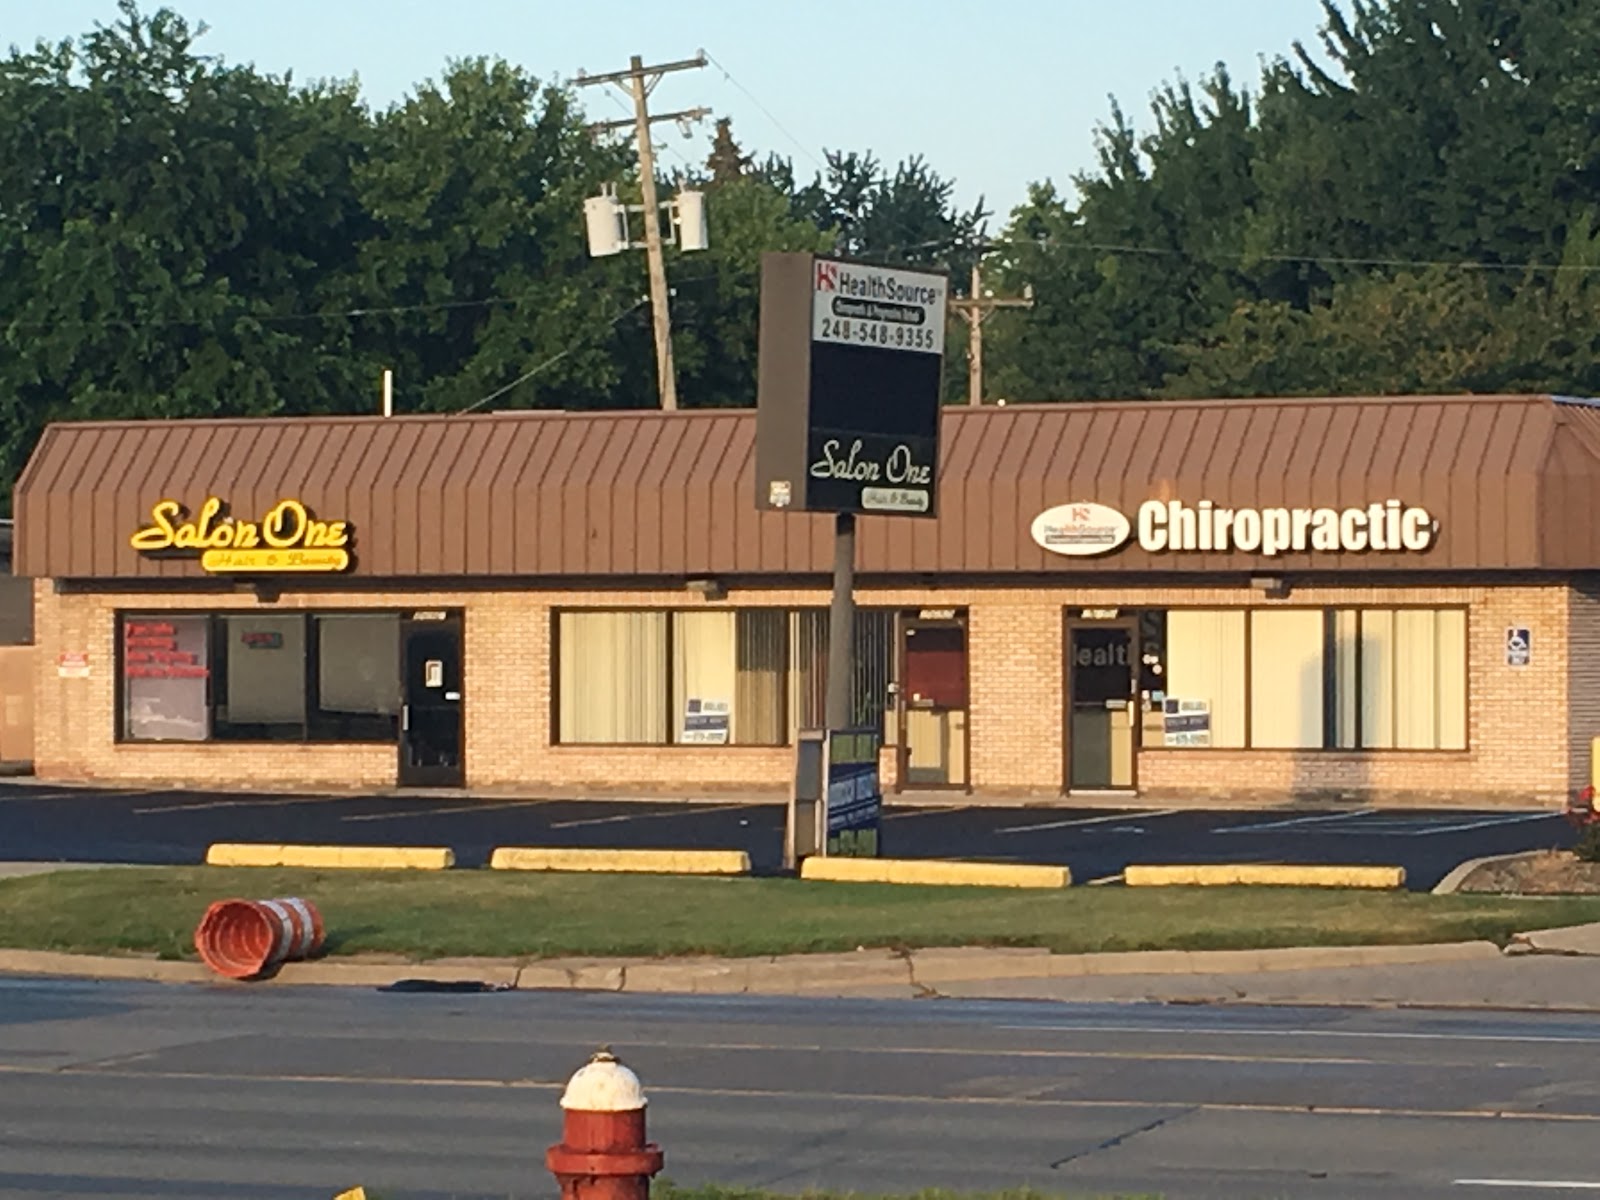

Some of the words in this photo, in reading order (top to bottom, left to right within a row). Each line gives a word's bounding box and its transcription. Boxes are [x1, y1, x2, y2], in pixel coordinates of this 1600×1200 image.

[839, 272, 936, 305] HealthSource
[821, 318, 933, 349] 248-548-9355
[810, 439, 881, 481] Salon
[886, 444, 931, 484] One
[130, 497, 259, 549] Salon
[263, 499, 349, 548] One
[1138, 499, 1431, 555] Chiropractic
